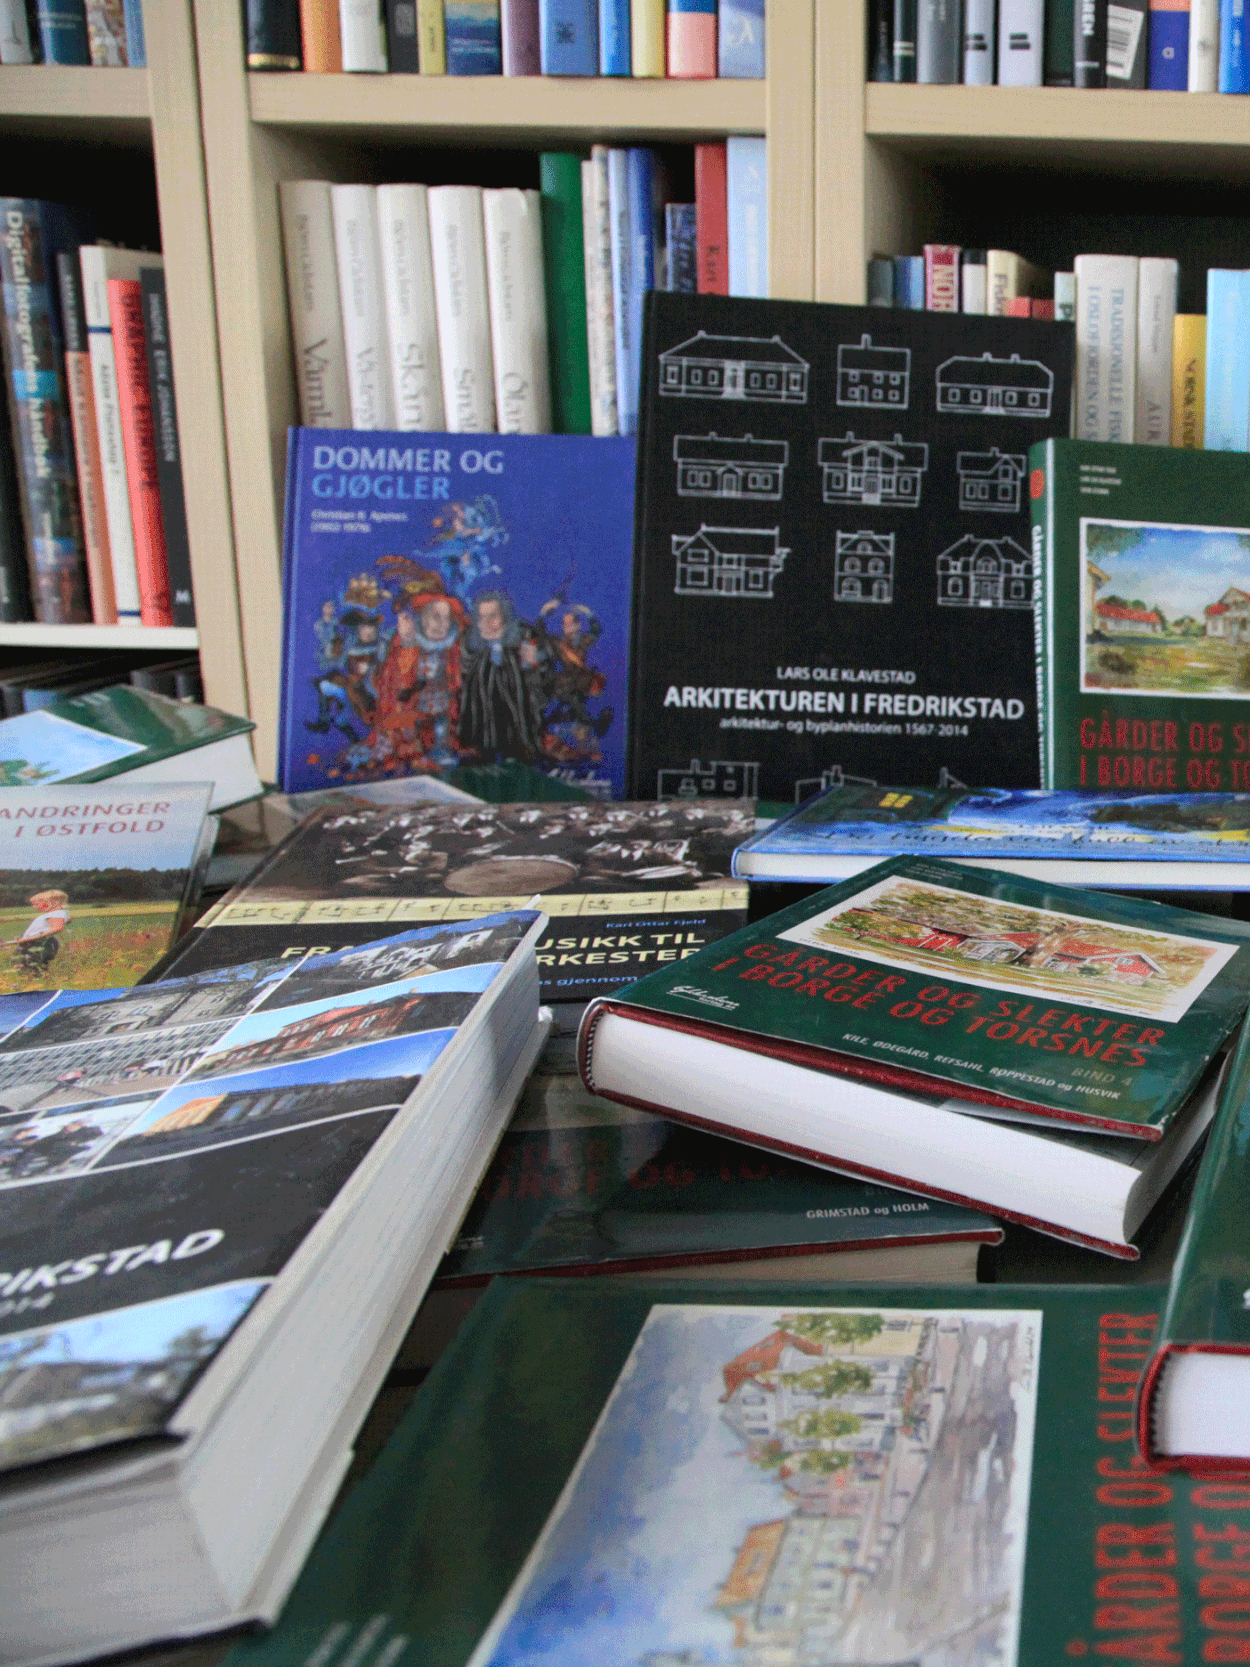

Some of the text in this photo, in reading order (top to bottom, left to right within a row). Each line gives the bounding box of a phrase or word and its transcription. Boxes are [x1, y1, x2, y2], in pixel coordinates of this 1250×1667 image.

[1108, 288, 1124, 405] TRADISJONELLE
[313, 446, 505, 475] DOMMER OG
[311, 474, 451, 500] GJØGLER
[776, 666, 916, 685] LARS OLE KLAVESTAD
[663, 685, 1025, 721] ARKITEKTUREN I FREDRIKSTAD
[786, 721, 804, 735] og
[806, 719, 902, 735] byplanhistorien
[1079, 709, 1180, 751] GÅRDER
[1189, 722, 1224, 752] OG
[1079, 755, 1087, 786] I
[1097, 755, 1178, 790] BORGE
[1187, 758, 1222, 791] OG
[15, 820, 165, 838] I ØSTFOLD
[534, 935, 642, 950] USIKK
[650, 933, 705, 946] TIL
[556, 975, 638, 986] gjennom
[743, 943, 1167, 1046] GÅRDER OG SLEKTER
[711, 957, 1148, 1068] I BORGE OG TORSNES
[1071, 1067, 1135, 1088] BIND 4
[1057, 1083, 1075, 1093] og
[1075, 1086, 1122, 1102] HUSVIK
[806, 1203, 930, 1219] GRIMSTAD og HOLM
[1065, 1521, 1184, 1667] ÅRDER
